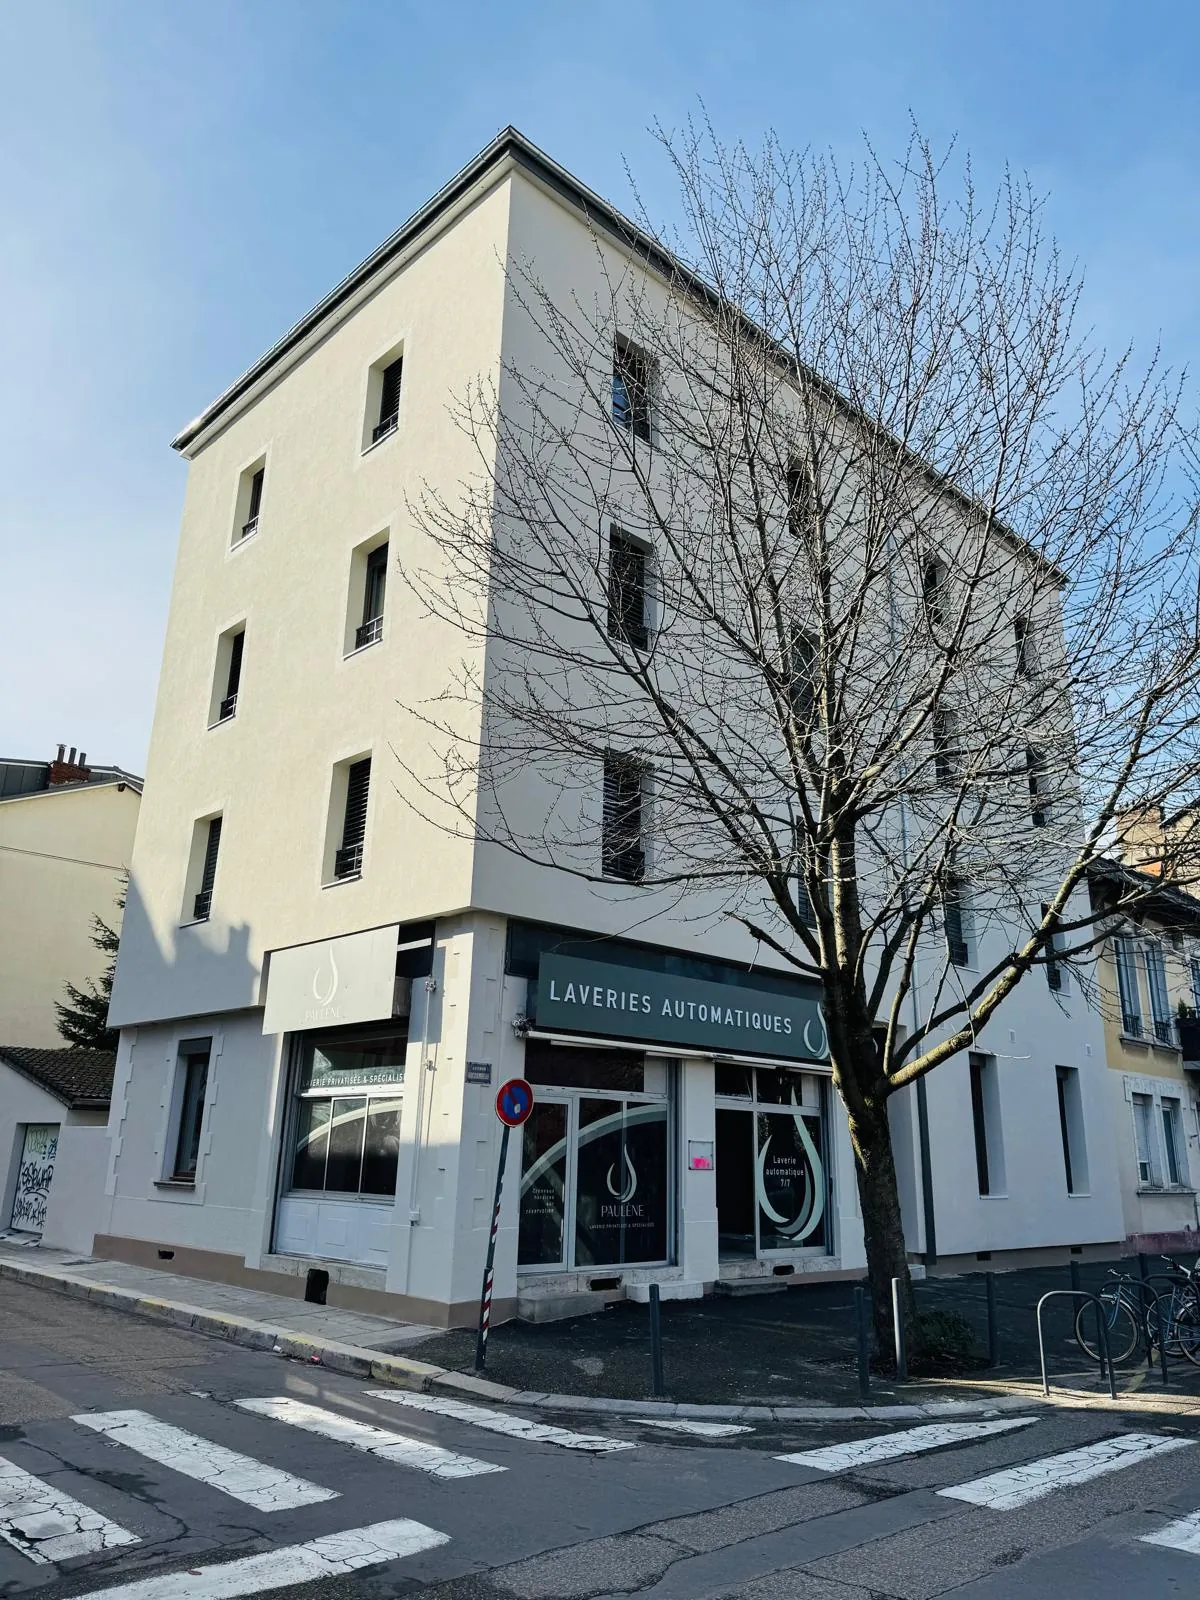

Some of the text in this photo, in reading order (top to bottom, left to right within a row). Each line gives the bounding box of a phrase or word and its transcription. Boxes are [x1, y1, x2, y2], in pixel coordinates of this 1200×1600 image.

[549, 980, 792, 1034] LAVERIES AUTOMATIQUES
[773, 1155, 797, 1165] Laverie
[766, 1168, 804, 1178] automatique
[601, 1202, 645, 1217] PAULÈNE
